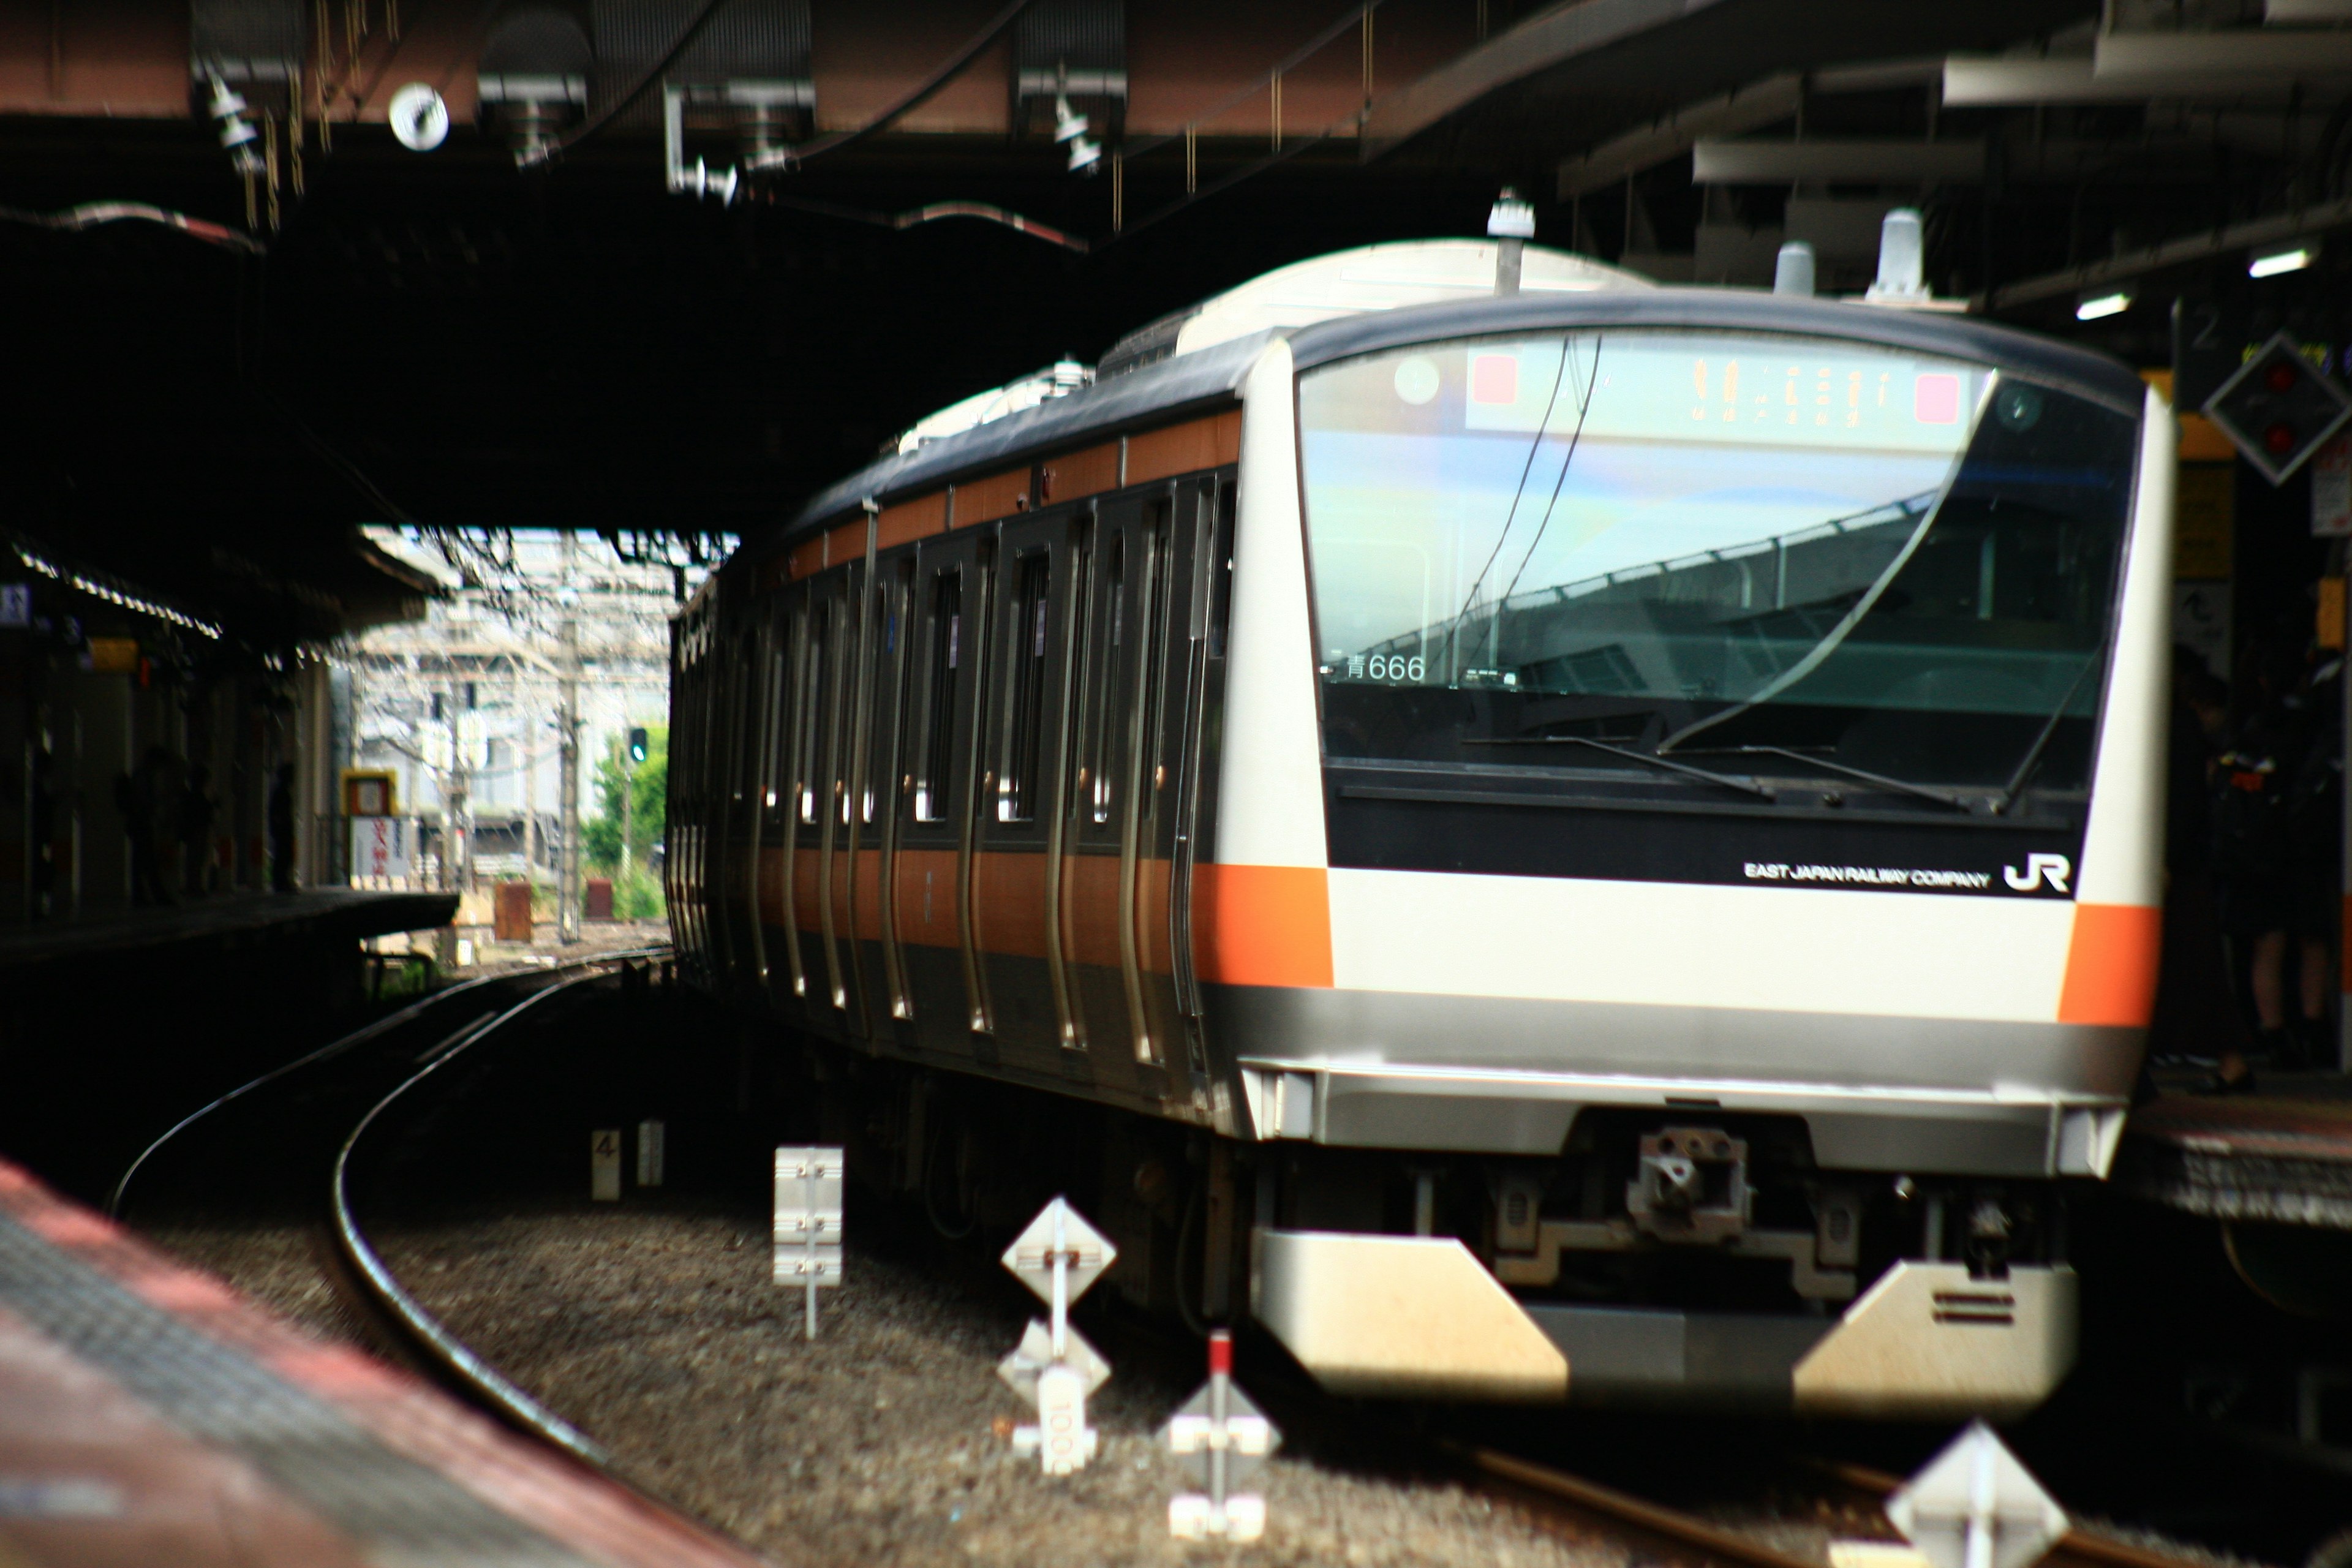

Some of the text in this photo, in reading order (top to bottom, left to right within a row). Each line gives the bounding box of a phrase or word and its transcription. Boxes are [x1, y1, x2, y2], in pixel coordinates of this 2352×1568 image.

[1744, 862, 1991, 888] EAST JAPAN RAILWAY COMPANY
[2003, 852, 2070, 892] JR
[595, 1134, 616, 1158] 4
